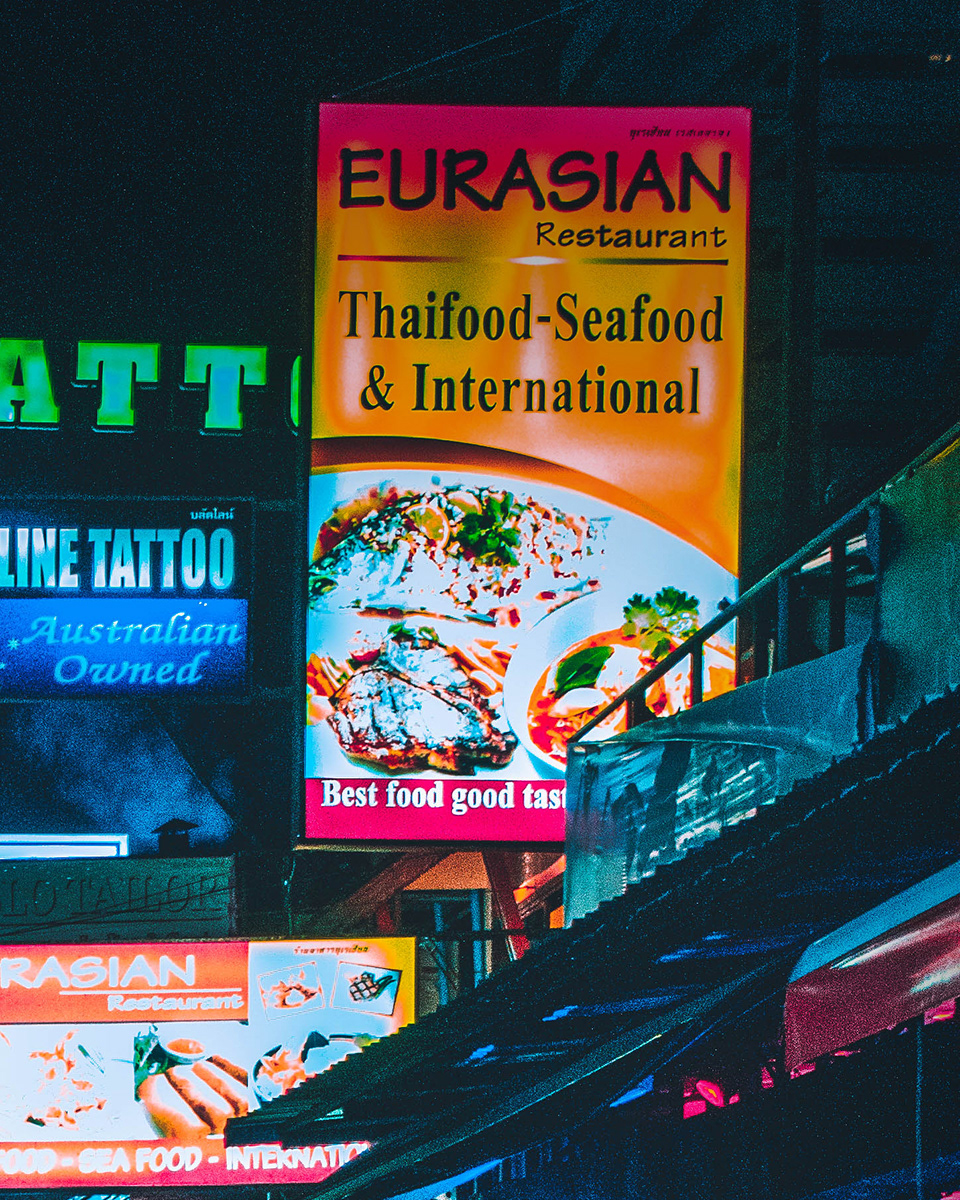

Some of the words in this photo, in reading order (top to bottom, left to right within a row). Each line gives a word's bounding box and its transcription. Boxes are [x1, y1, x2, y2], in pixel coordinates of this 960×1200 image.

[339, 148, 731, 213] EURASIAN
[536, 222, 727, 248] Restaurant
[339, 291, 724, 343] Thaifood-Seafood
[360, 364, 395, 411] &
[412, 364, 700, 414] International
[88, 527, 235, 590] TATTOO
[22, 612, 243, 647] Australian
[53, 651, 211, 685] Owned
[321, 780, 378, 807] Best
[385, 781, 444, 808] food
[452, 782, 515, 815] good
[107, 994, 244, 1012] Restaurant
[78, 1148, 131, 1173] SEA
[135, 1146, 203, 1172] FOOD
